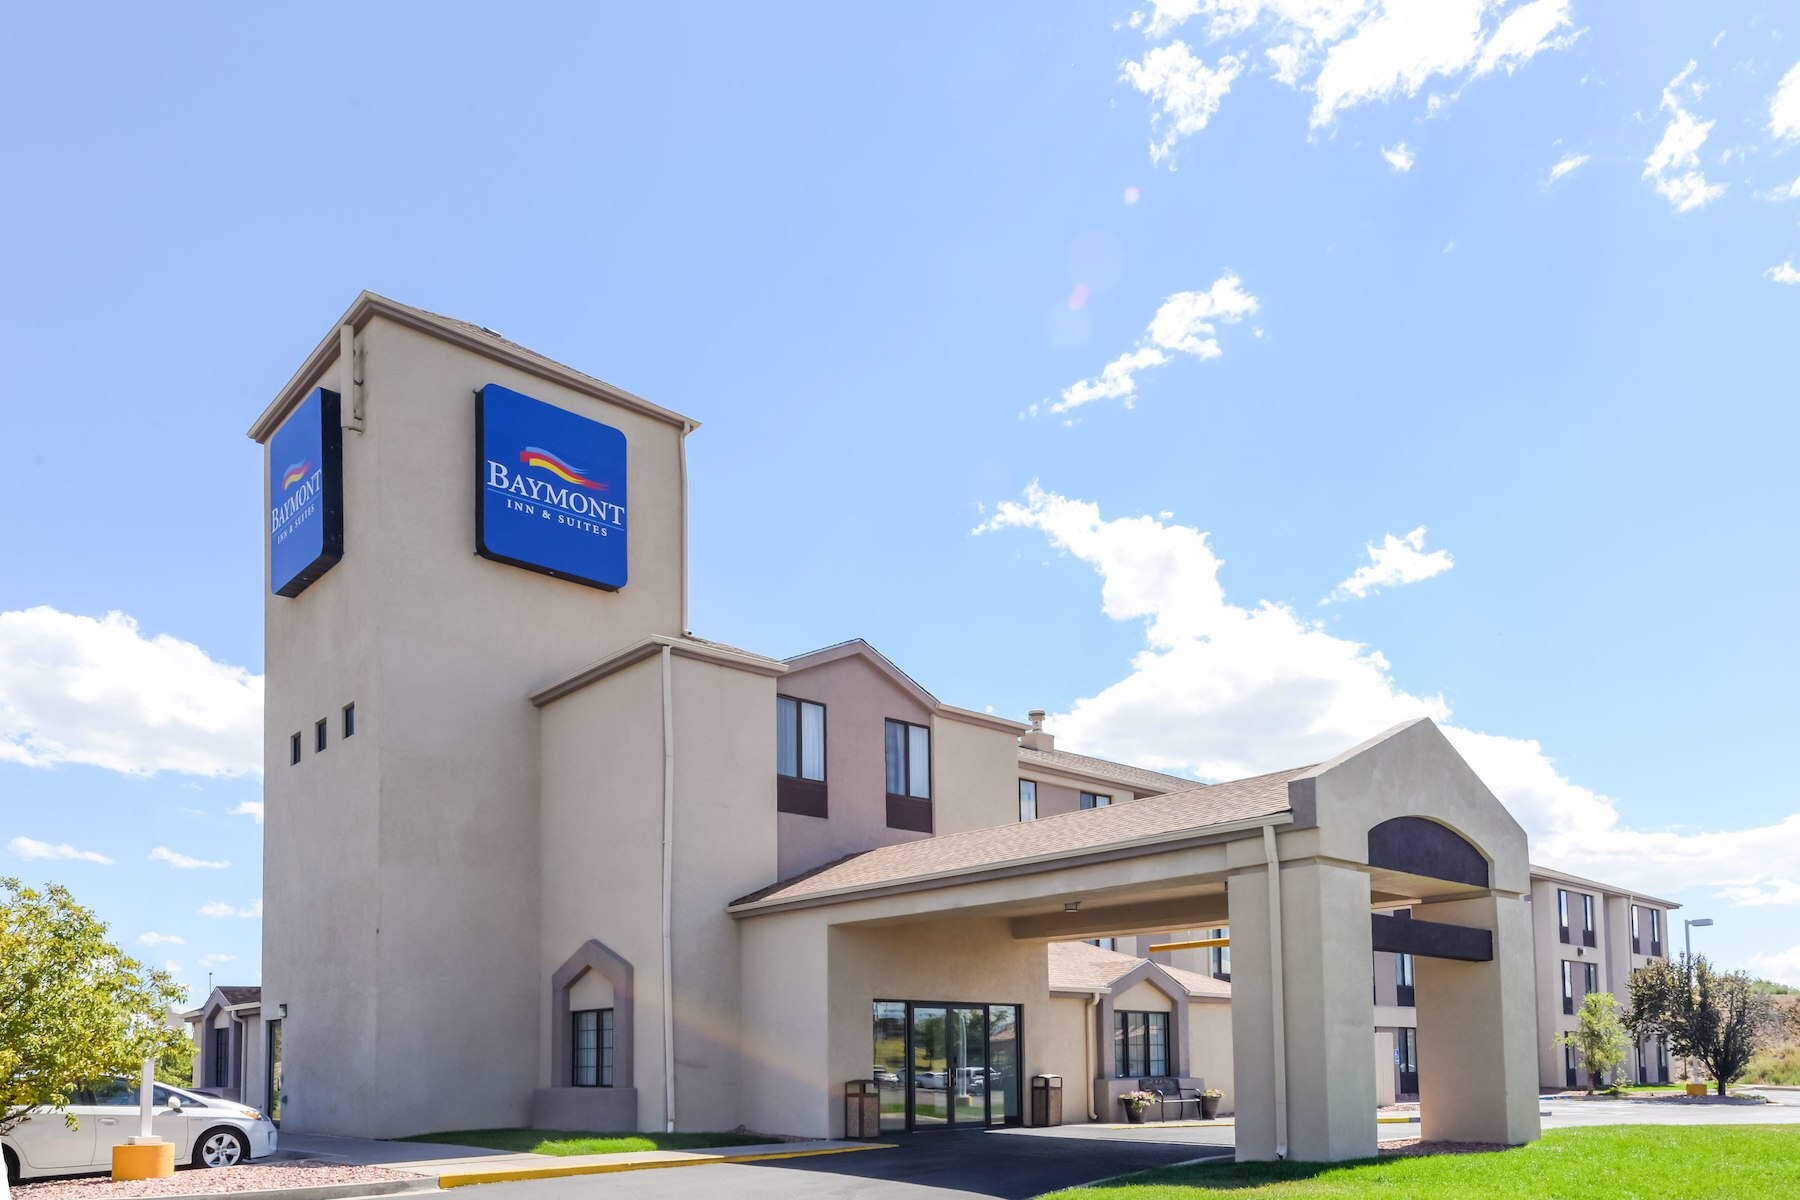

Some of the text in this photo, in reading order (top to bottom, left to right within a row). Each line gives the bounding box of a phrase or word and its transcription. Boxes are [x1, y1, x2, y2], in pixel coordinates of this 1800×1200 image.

[272, 468, 322, 533] BAYMONT
[295, 503, 315, 528] SUITES
[487, 460, 625, 526] BAYMONT
[507, 499, 608, 537] INN & SUITES
